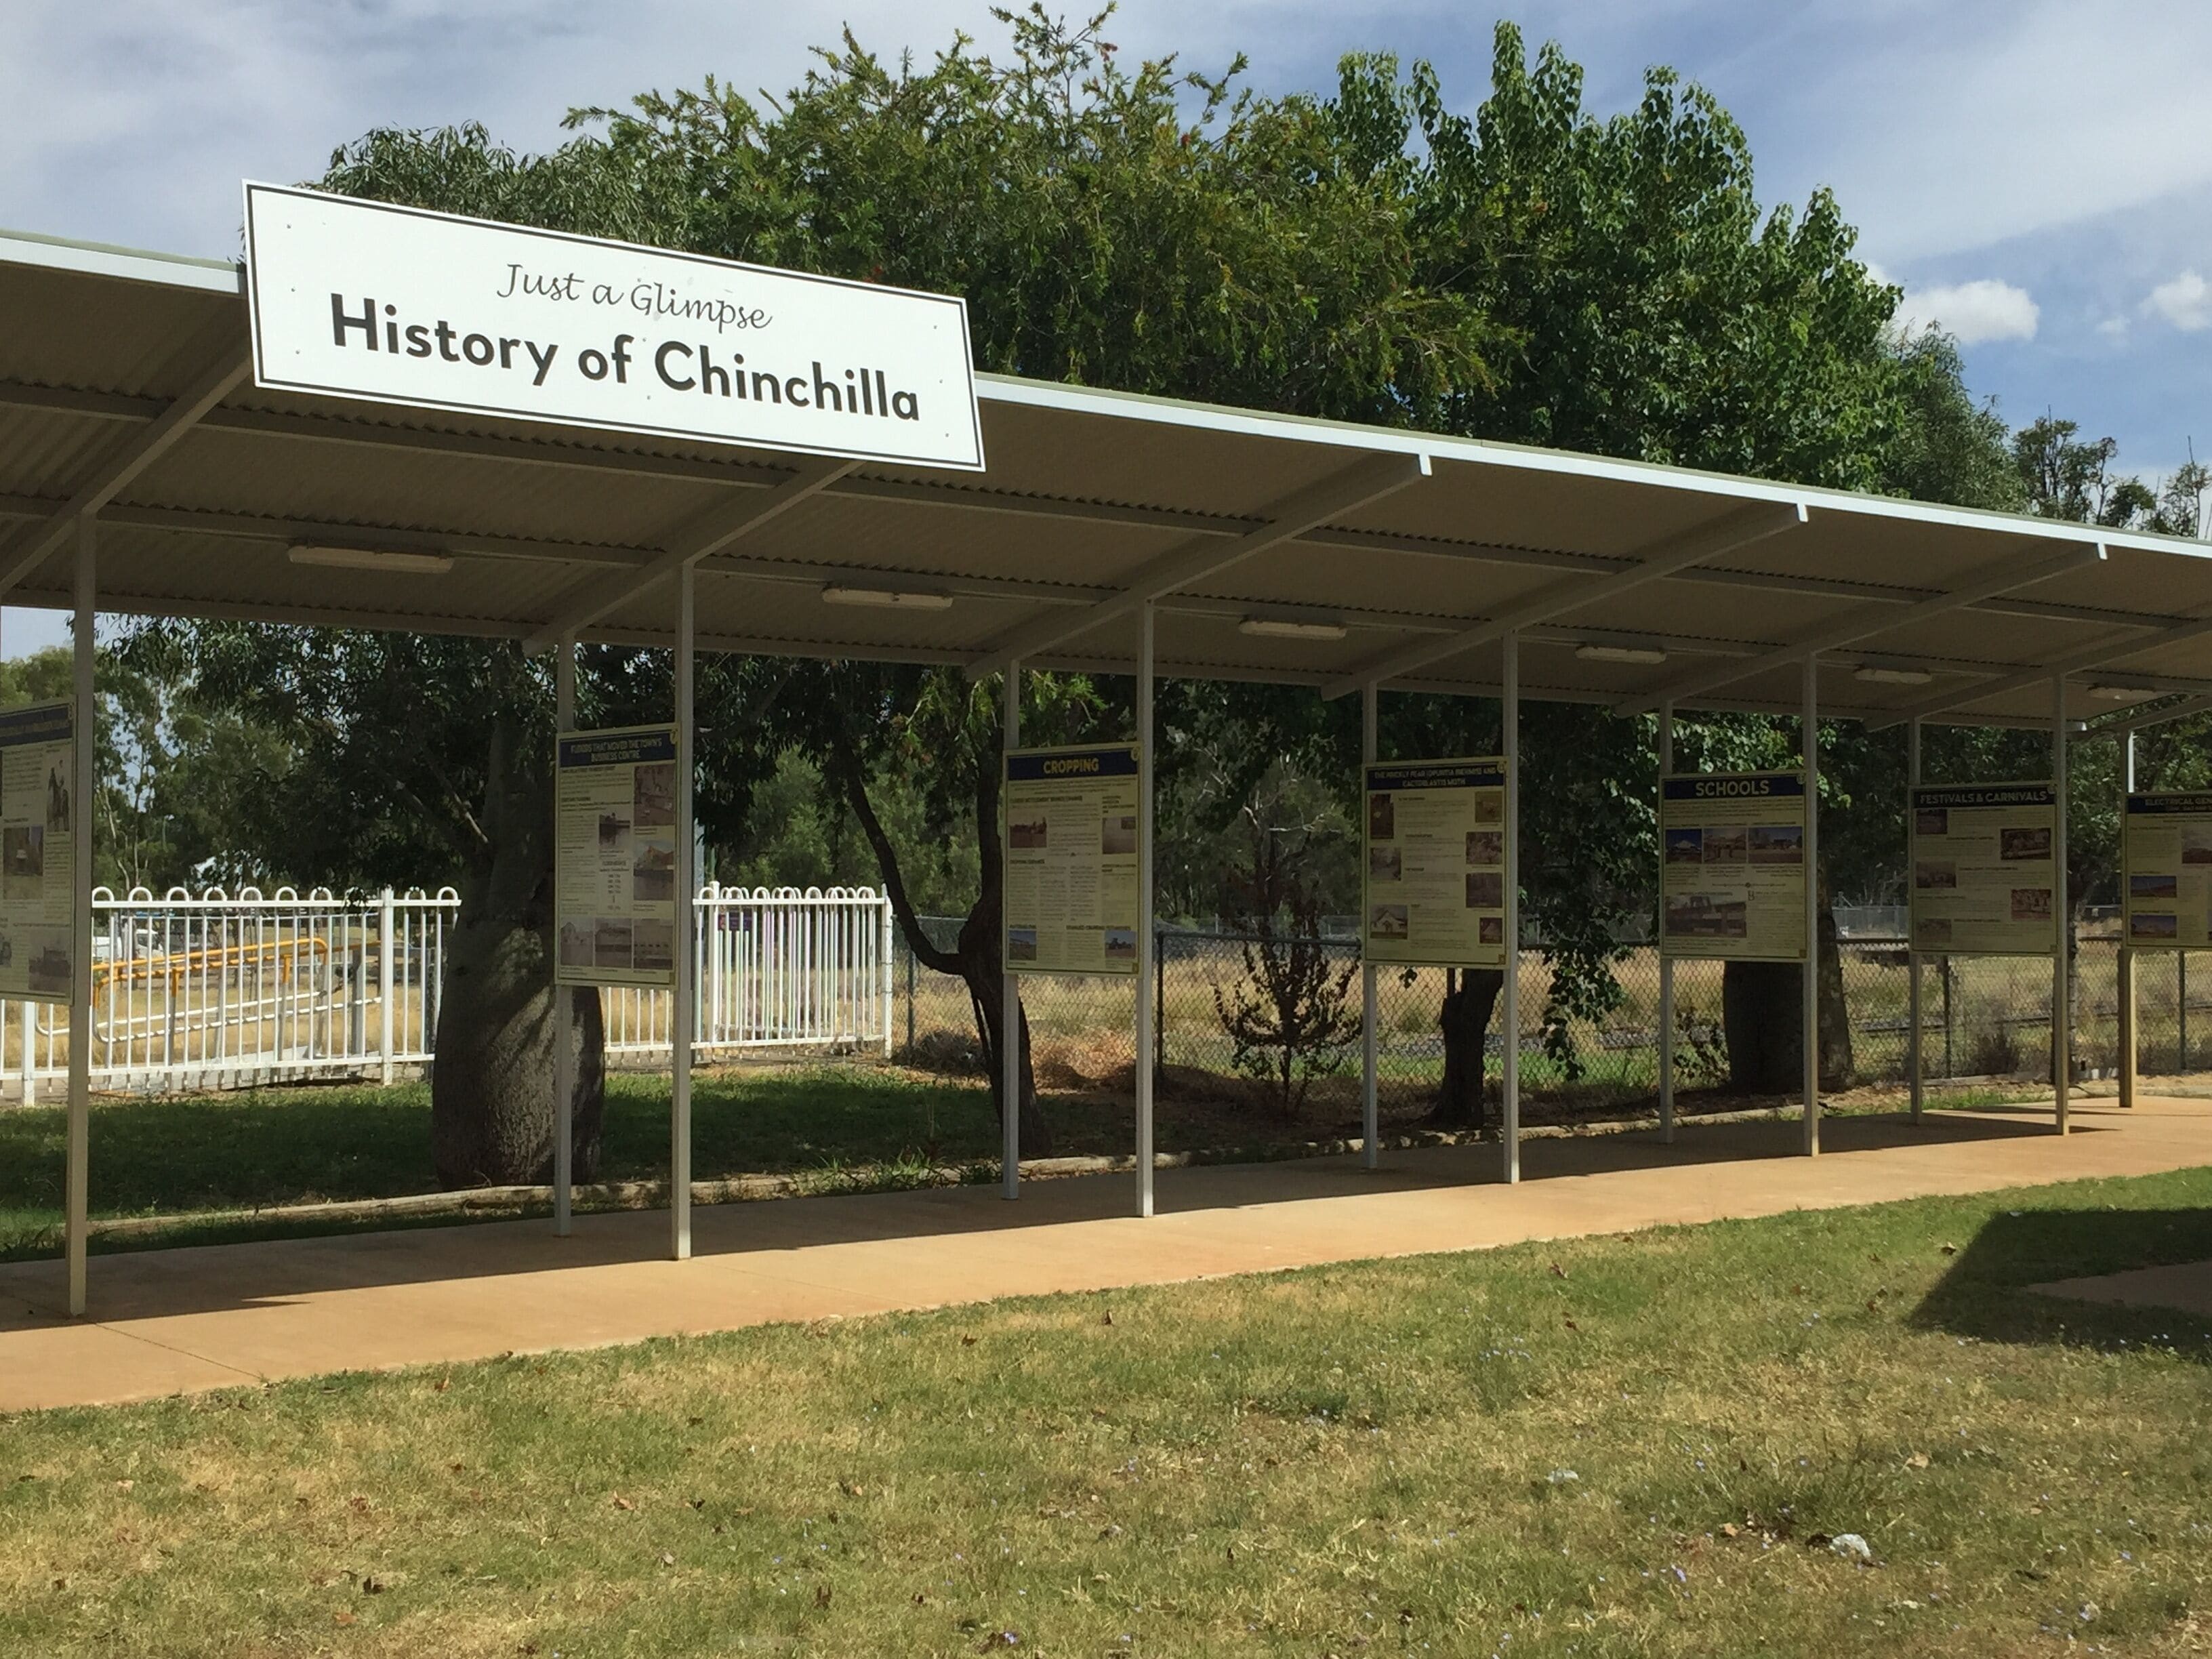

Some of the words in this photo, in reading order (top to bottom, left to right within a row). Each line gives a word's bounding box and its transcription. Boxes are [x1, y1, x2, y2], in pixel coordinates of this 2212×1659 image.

[497, 264, 584, 300] Just
[593, 285, 623, 305] a
[632, 282, 772, 333] Glimpse
[331, 293, 558, 386] History
[579, 334, 634, 384] of
[654, 340, 919, 421] Chinchilla
[1043, 757, 1099, 774] CROPPING
[1695, 779, 1770, 797] SCHOOLS
[1919, 793, 1974, 804] FESTIVALS
[1975, 793, 1984, 803] &
[1985, 790, 2047, 803] CARNIVALS
[2144, 797, 2194, 806] ELECTRICAL
